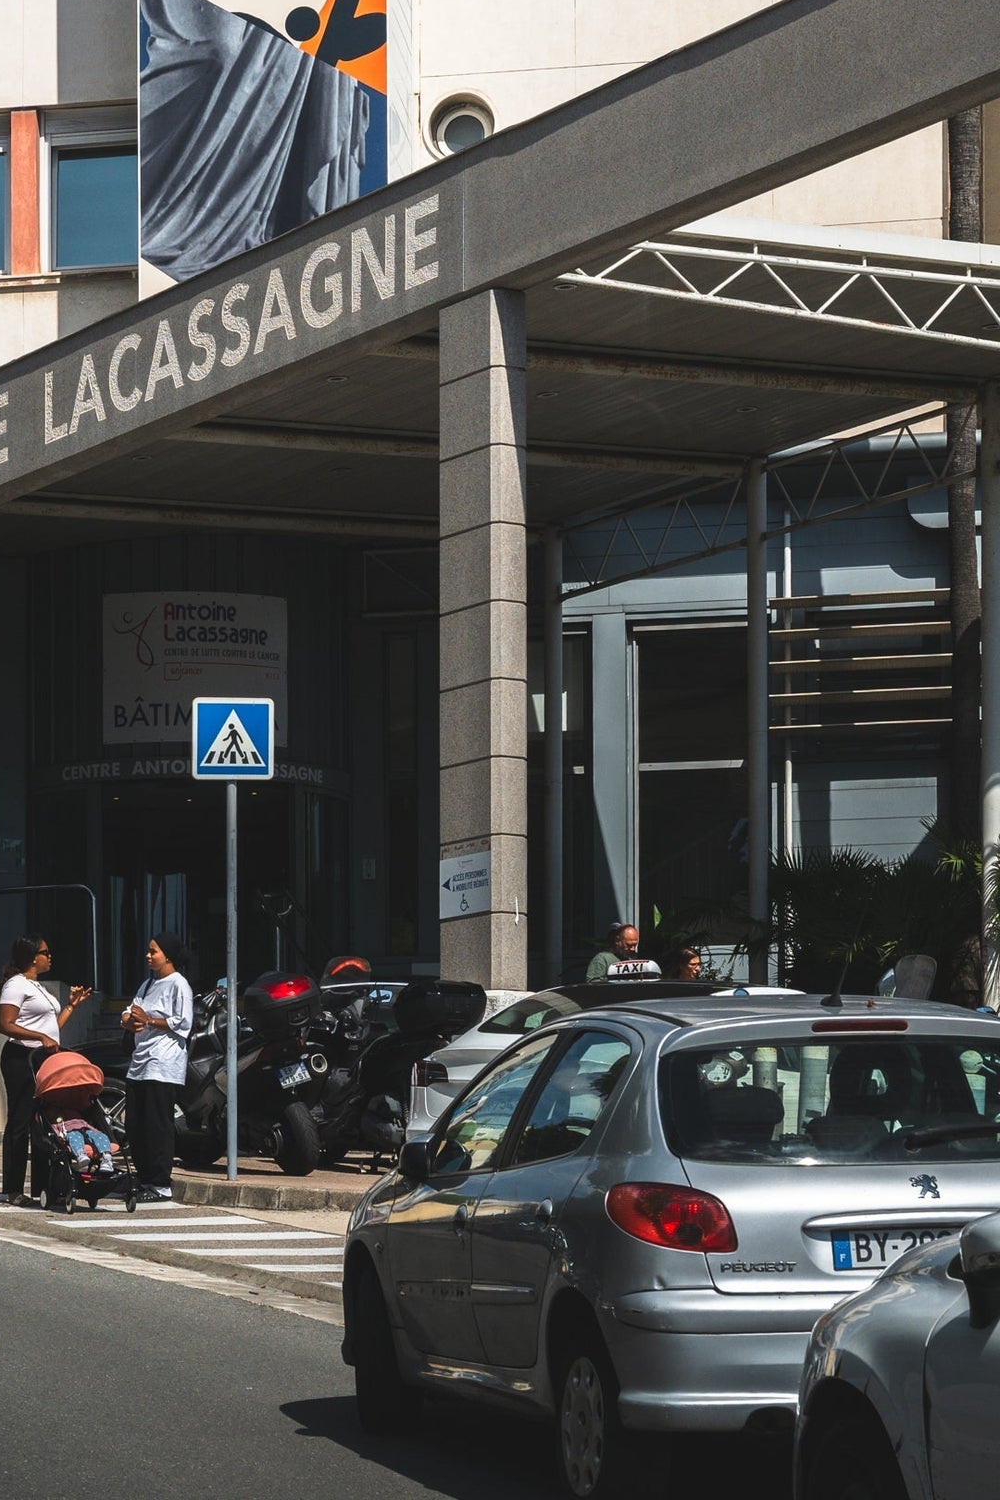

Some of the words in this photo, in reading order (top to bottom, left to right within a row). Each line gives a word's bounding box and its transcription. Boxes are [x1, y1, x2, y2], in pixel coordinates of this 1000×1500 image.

[44, 193, 440, 445] LACASSAGNE
[163, 601, 237, 622] Antoine
[164, 624, 269, 646] Lacassagne
[164, 648, 188, 657] CENTRE
[191, 648, 199, 657] DE
[201, 648, 220, 658] LUTTE
[222, 649, 248, 659] CONTRE
[249, 650, 257, 660] LE
[257, 651, 280, 662] CANCER
[113, 695, 193, 728] BÂTIM
[62, 762, 121, 781] CENTRE
[131, 759, 192, 776] ANTOI
[273, 763, 324, 784] SSAGNE
[464, 868, 488, 880] PERSONNES
[615, 963, 643, 974] TAXI
[854, 1230, 952, 1263] BY-2
[720, 1259, 797, 1273] PEUGEOT
